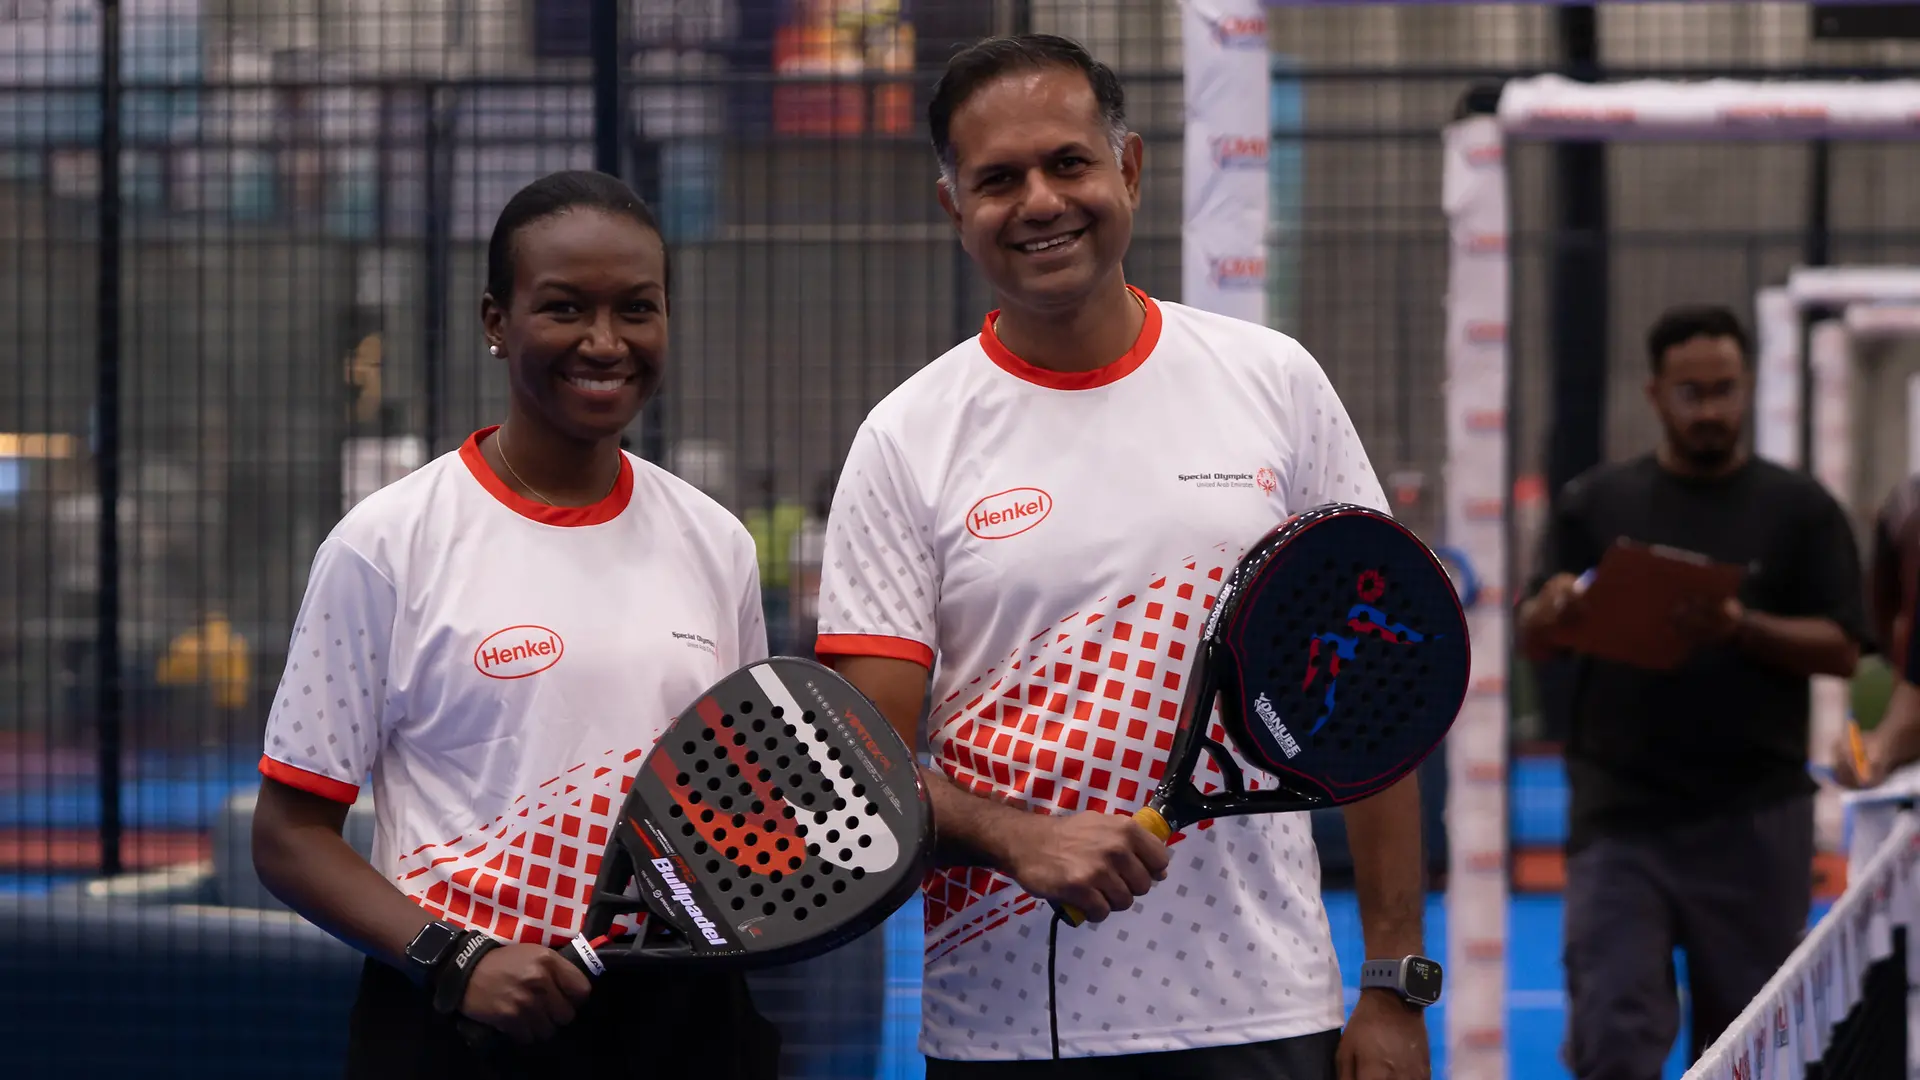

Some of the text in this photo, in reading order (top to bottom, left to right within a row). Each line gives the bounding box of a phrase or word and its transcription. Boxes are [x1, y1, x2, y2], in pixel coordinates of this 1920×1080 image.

[1178, 473, 1211, 481] Special
[974, 496, 1043, 530] Henkel
[482, 636, 556, 668] Henkel
[672, 631, 695, 640] Special
[1261, 702, 1301, 755] DANUBE
[650, 857, 728, 945] Bullpadel
